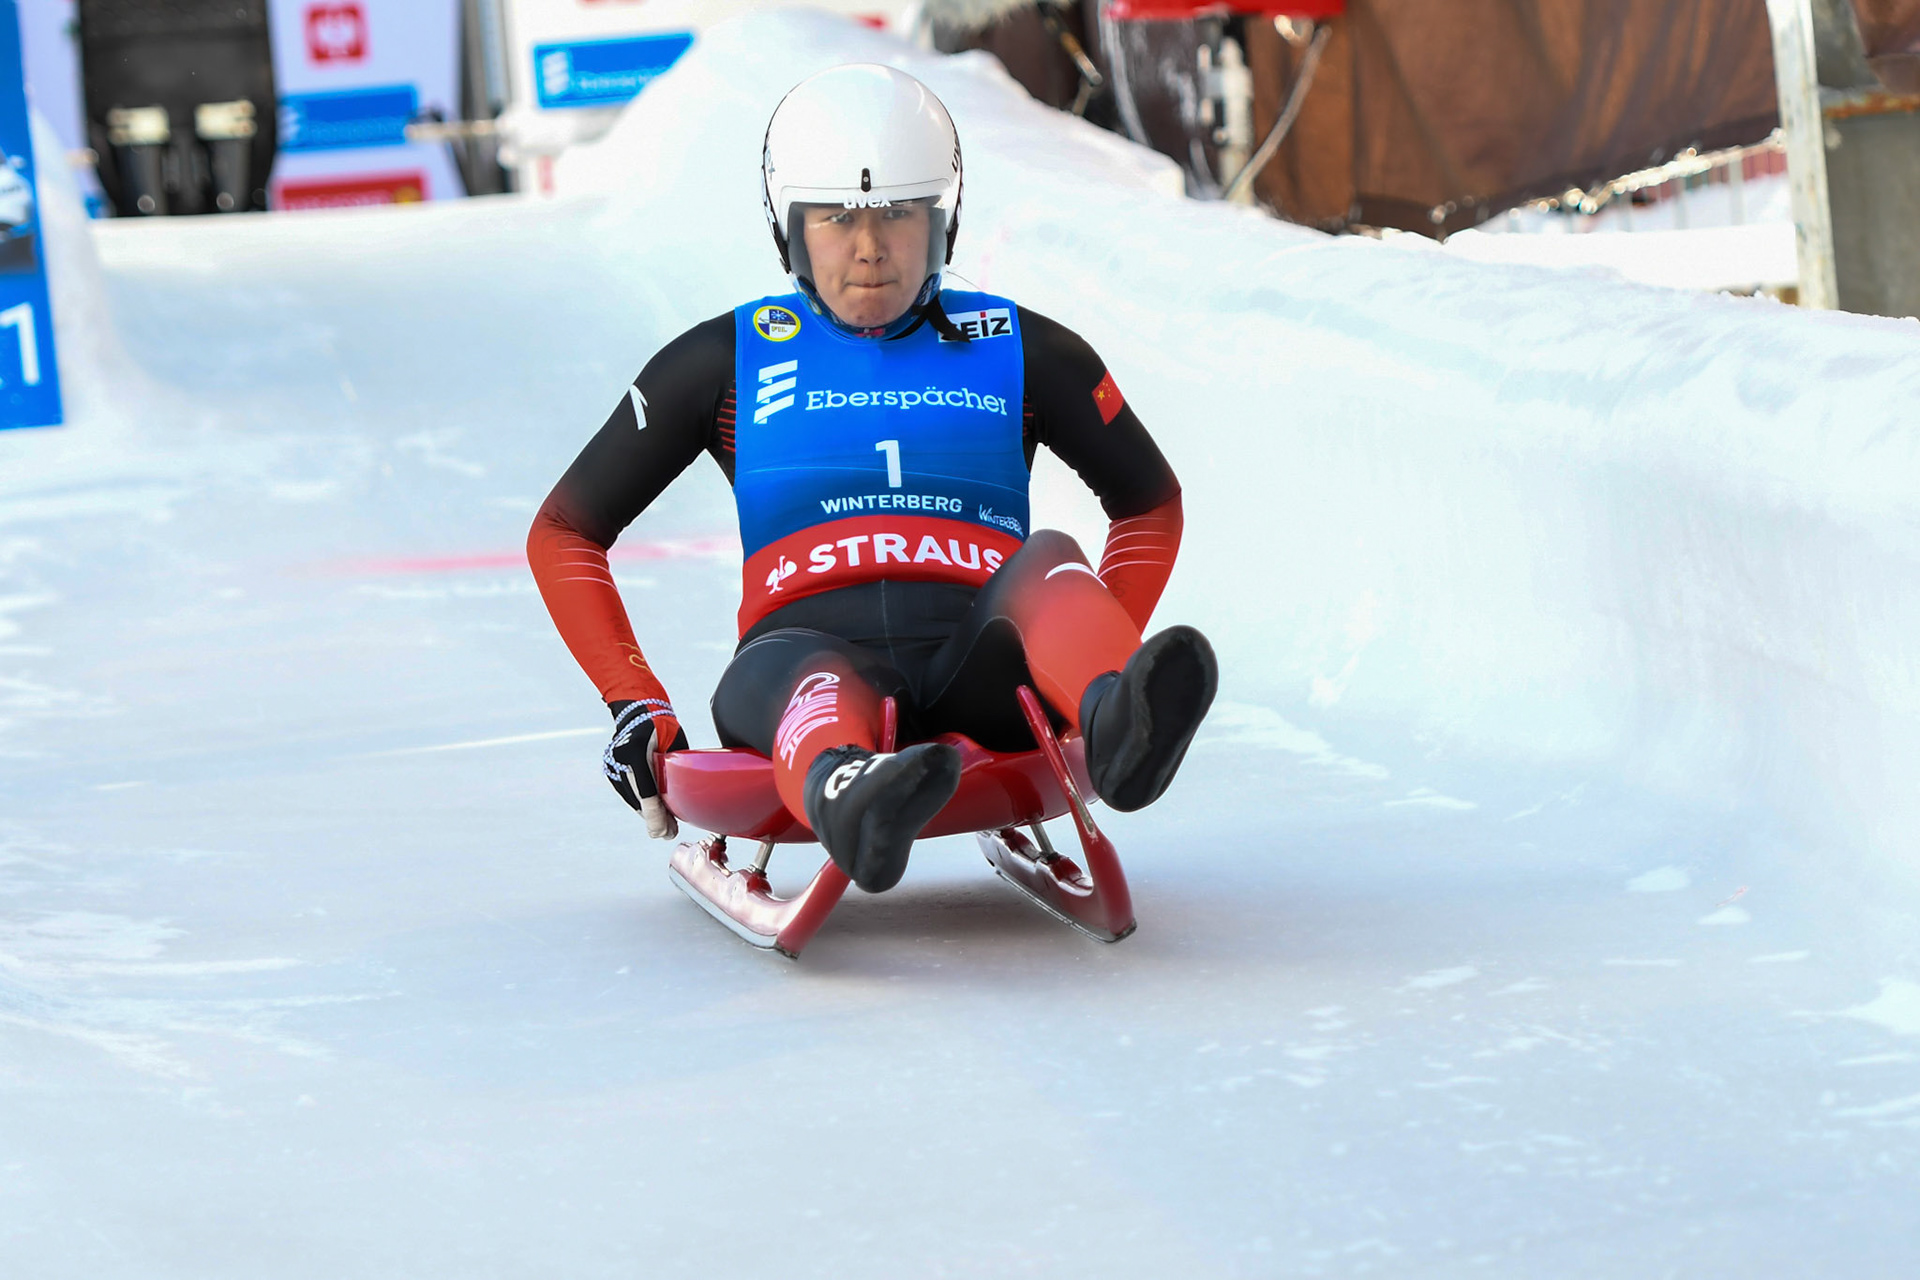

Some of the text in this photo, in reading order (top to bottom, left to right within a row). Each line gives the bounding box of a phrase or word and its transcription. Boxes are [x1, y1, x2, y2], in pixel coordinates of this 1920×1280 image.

[805, 386, 1008, 416] Eberspächer
[875, 439, 902, 488] 1
[820, 494, 963, 514] WINTERBERG
